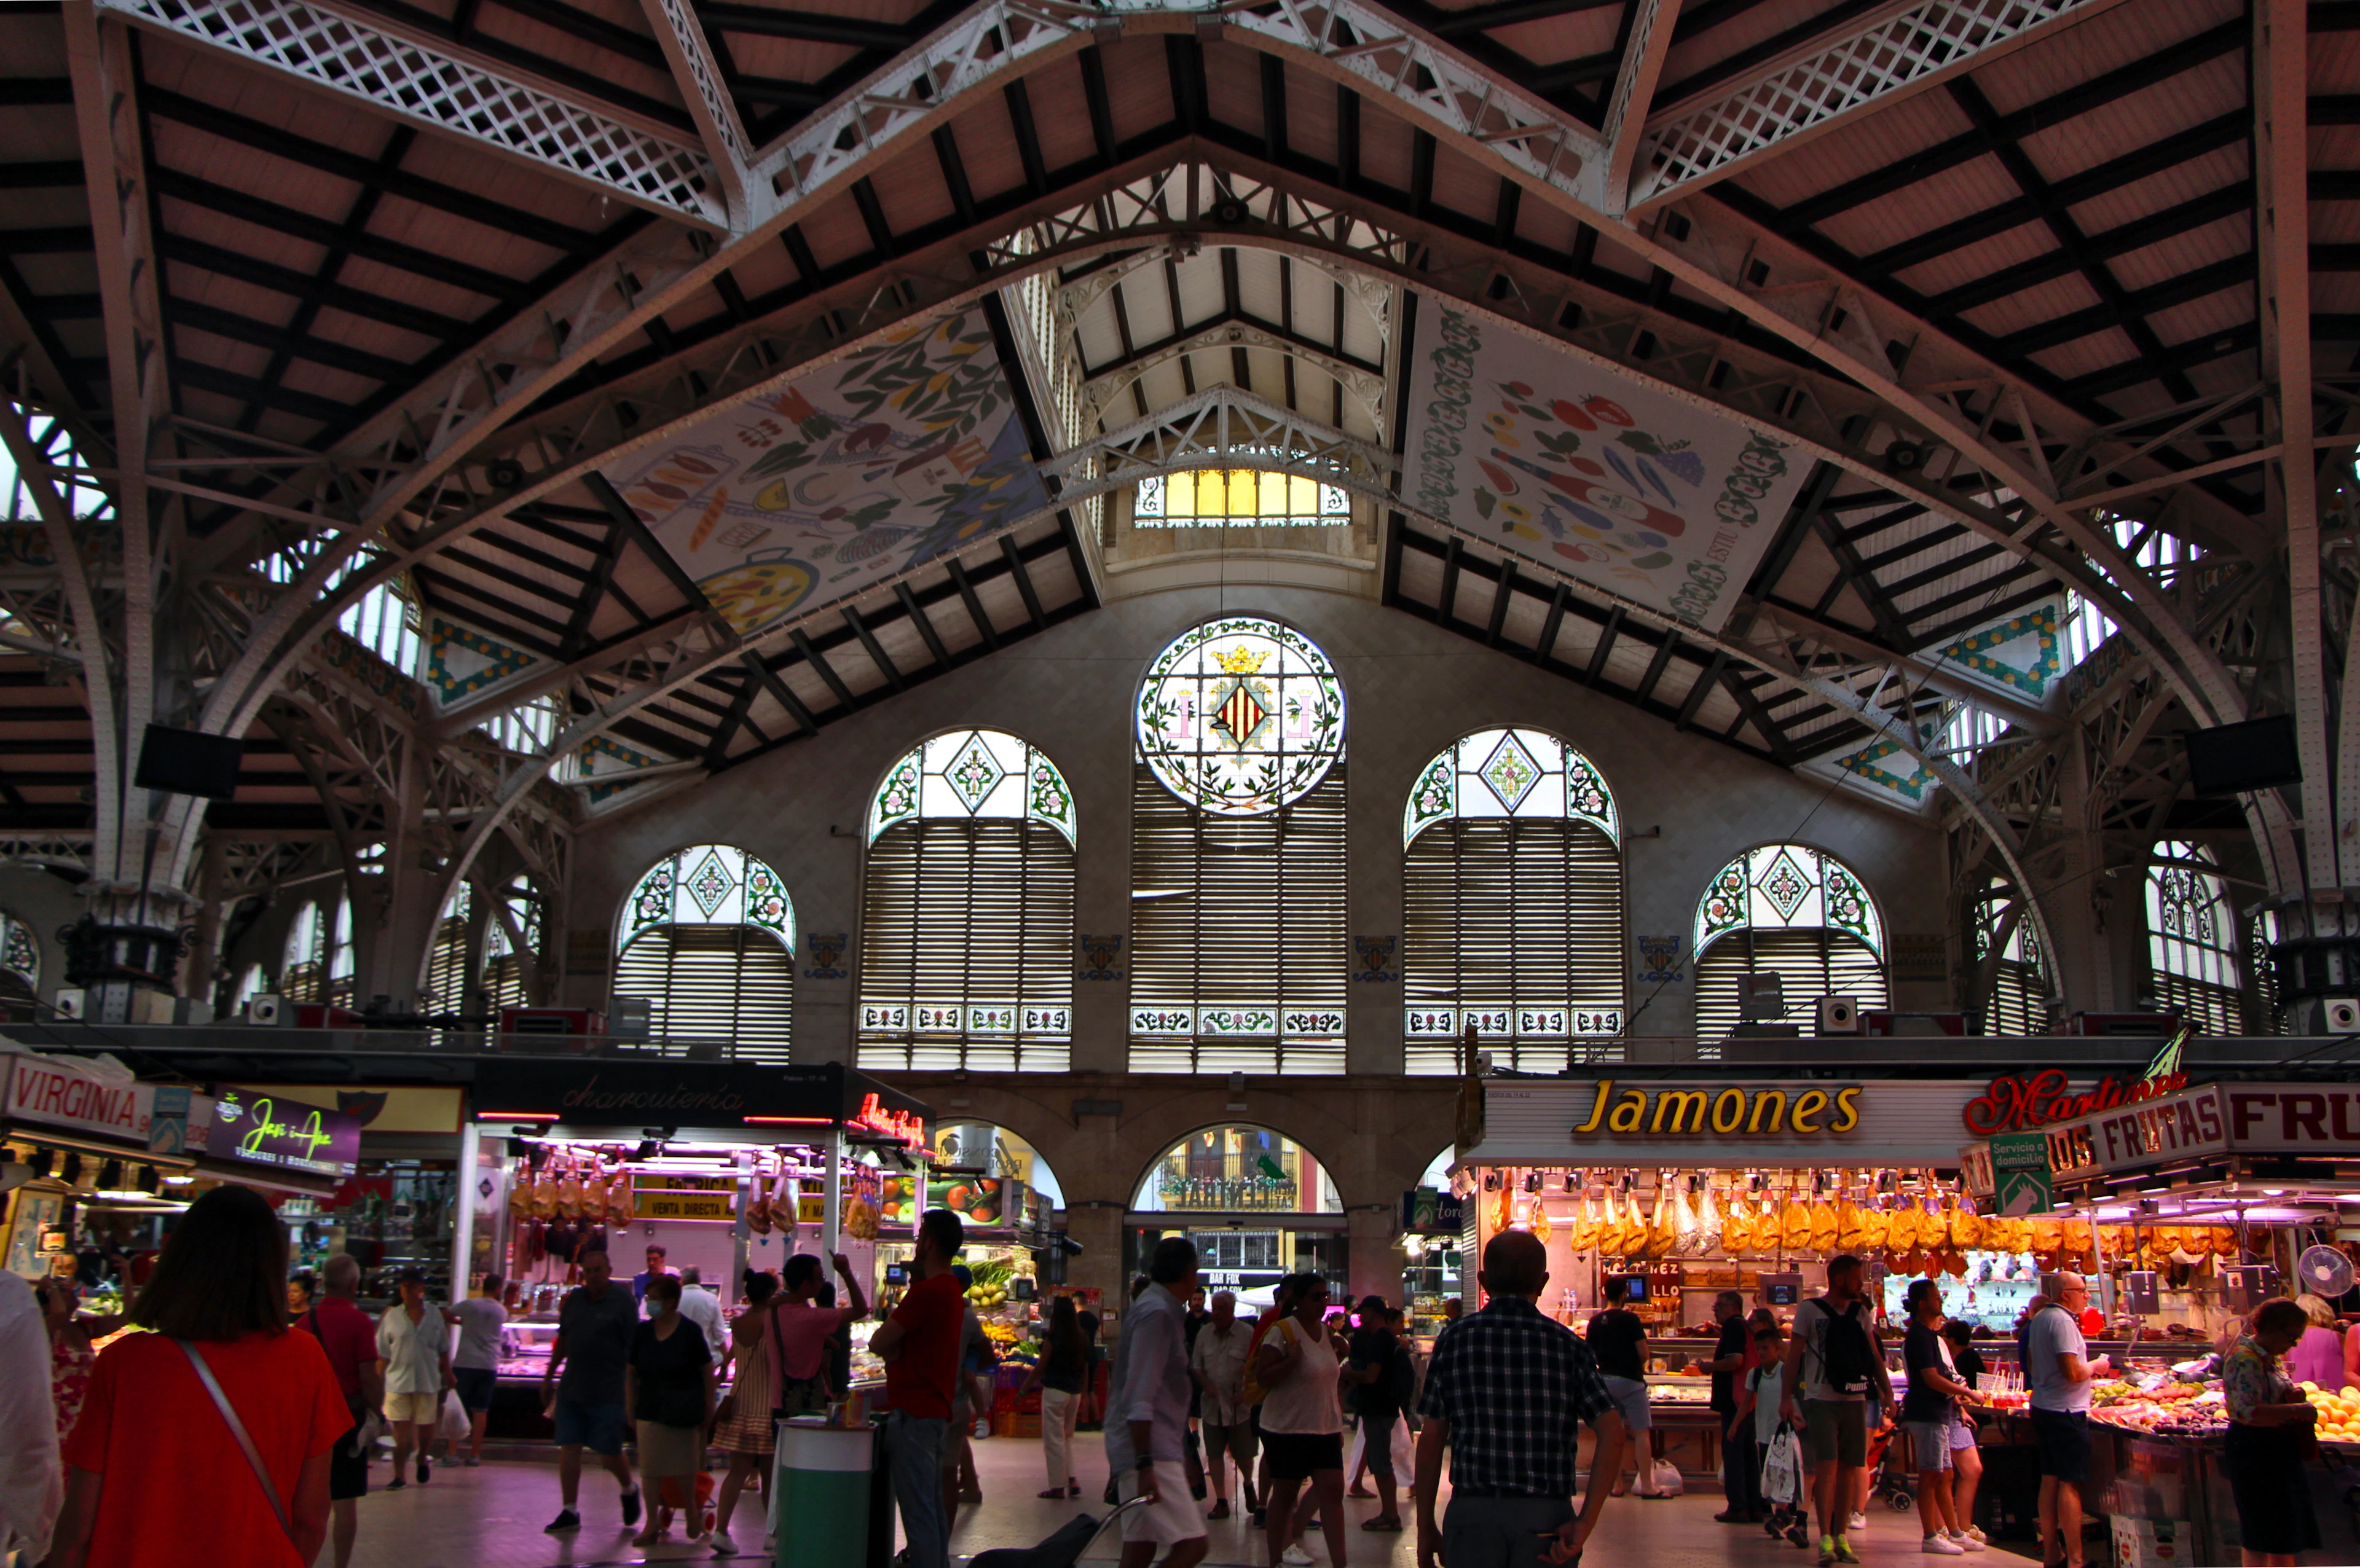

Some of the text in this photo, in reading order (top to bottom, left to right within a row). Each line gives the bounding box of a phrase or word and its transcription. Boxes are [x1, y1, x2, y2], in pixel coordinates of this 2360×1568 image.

[17, 1067, 135, 1128] VIRGINIA
[564, 1075, 745, 1110] charcutería
[1573, 1078, 1864, 1134] Jamones
[2102, 1094, 2223, 1161] FRUTAS
[1993, 1142, 2045, 1154] Servicio a
[1996, 1153, 2045, 1166] domicilio
[653, 1202, 680, 1215] VENTA
[684, 1202, 720, 1216] DIRECTA
[1209, 1273, 1240, 1285] BAR FOX
